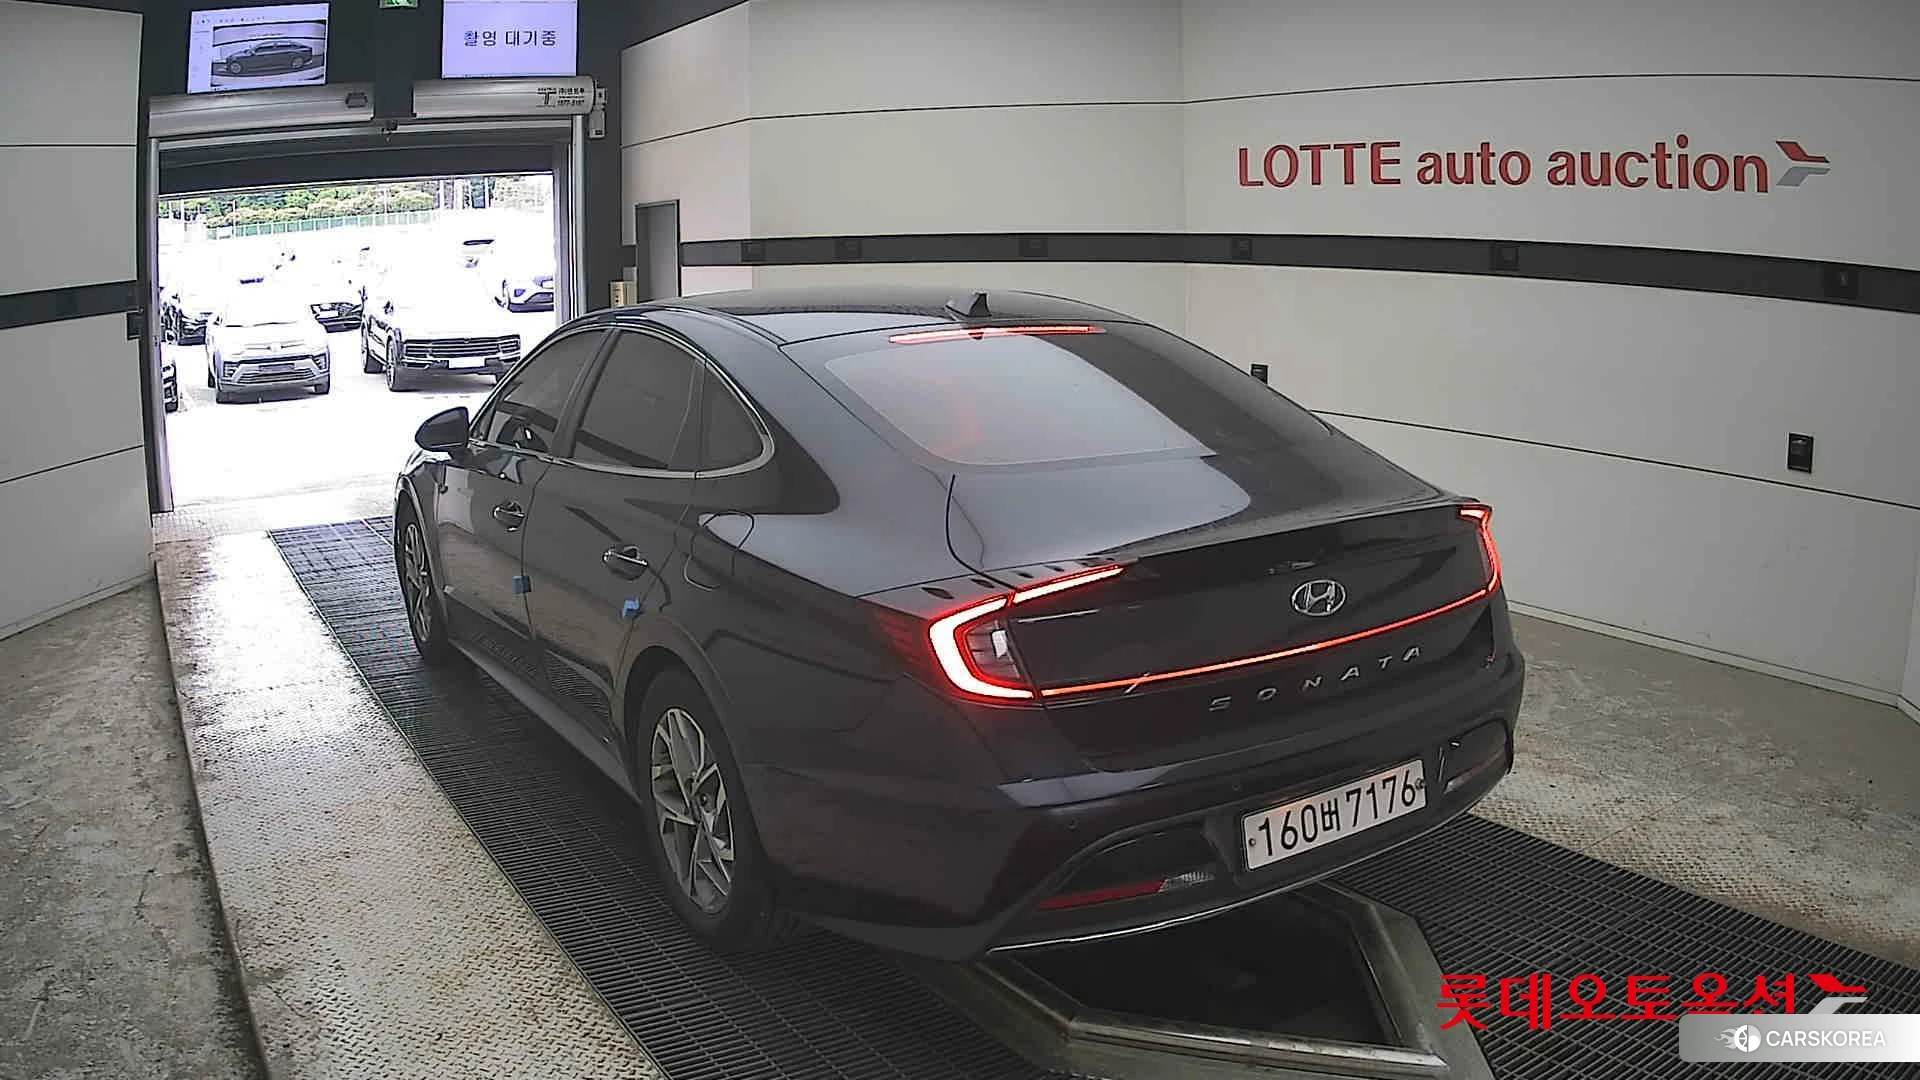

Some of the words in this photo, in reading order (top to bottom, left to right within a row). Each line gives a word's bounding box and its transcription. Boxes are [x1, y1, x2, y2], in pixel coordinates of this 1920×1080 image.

[505, 29, 557, 47] 대기중
[1238, 141, 1401, 188] LOTTE
[1416, 141, 1532, 186] auto
[1547, 134, 1769, 193] auction
[1208, 646, 1421, 712] SONATA
